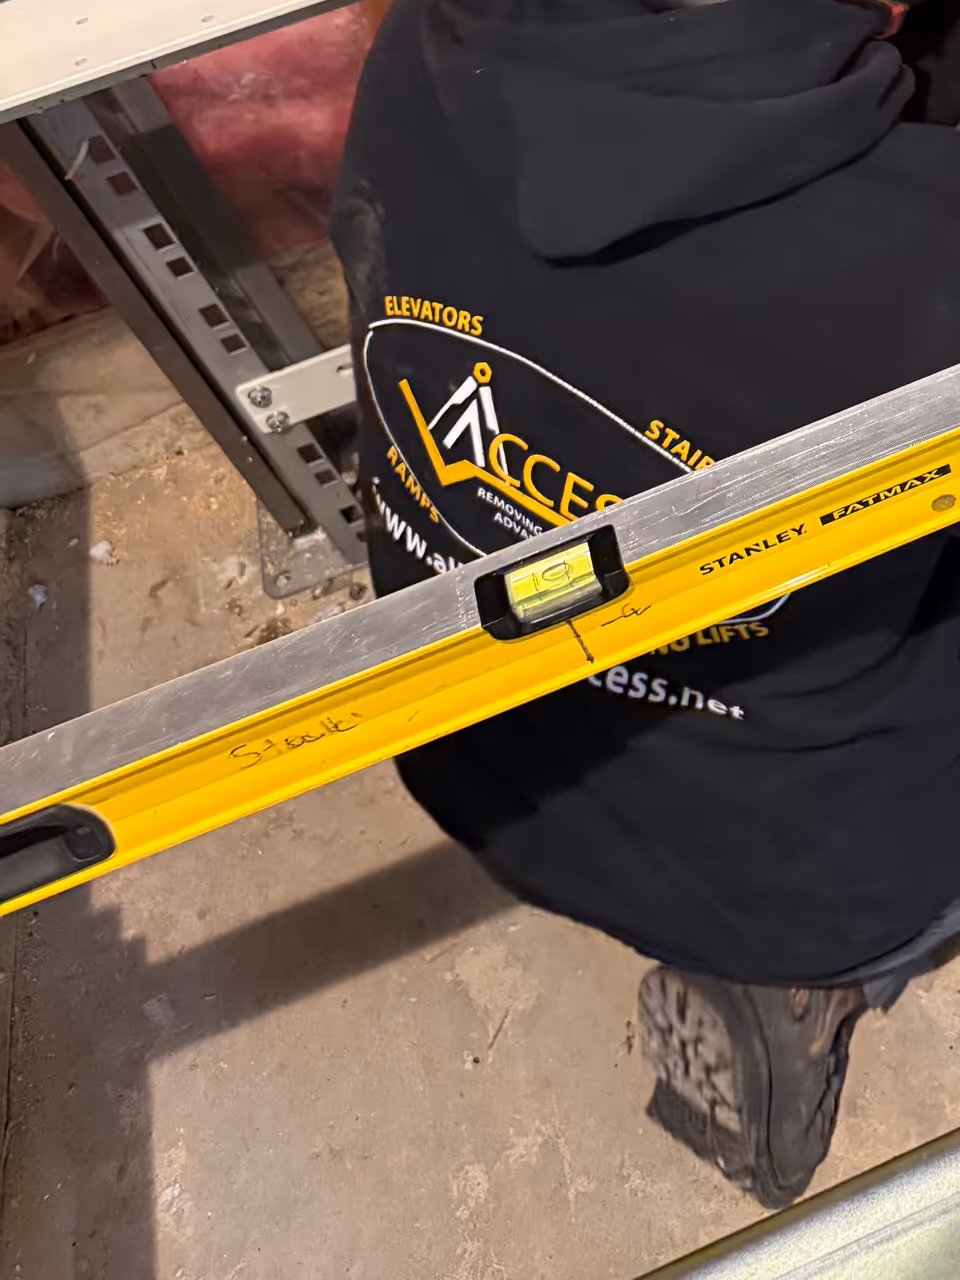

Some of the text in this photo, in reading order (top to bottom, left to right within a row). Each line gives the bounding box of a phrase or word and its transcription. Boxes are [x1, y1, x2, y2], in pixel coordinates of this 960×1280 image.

[384, 295, 484, 336] ELEVATORS
[386, 445, 439, 524] RAMPS
[477, 486, 544, 535] REMOVING
[493, 511, 534, 541] ADVA
[698, 468, 942, 576] STANLEY FATMAX
[696, 621, 770, 646] LIFTS
